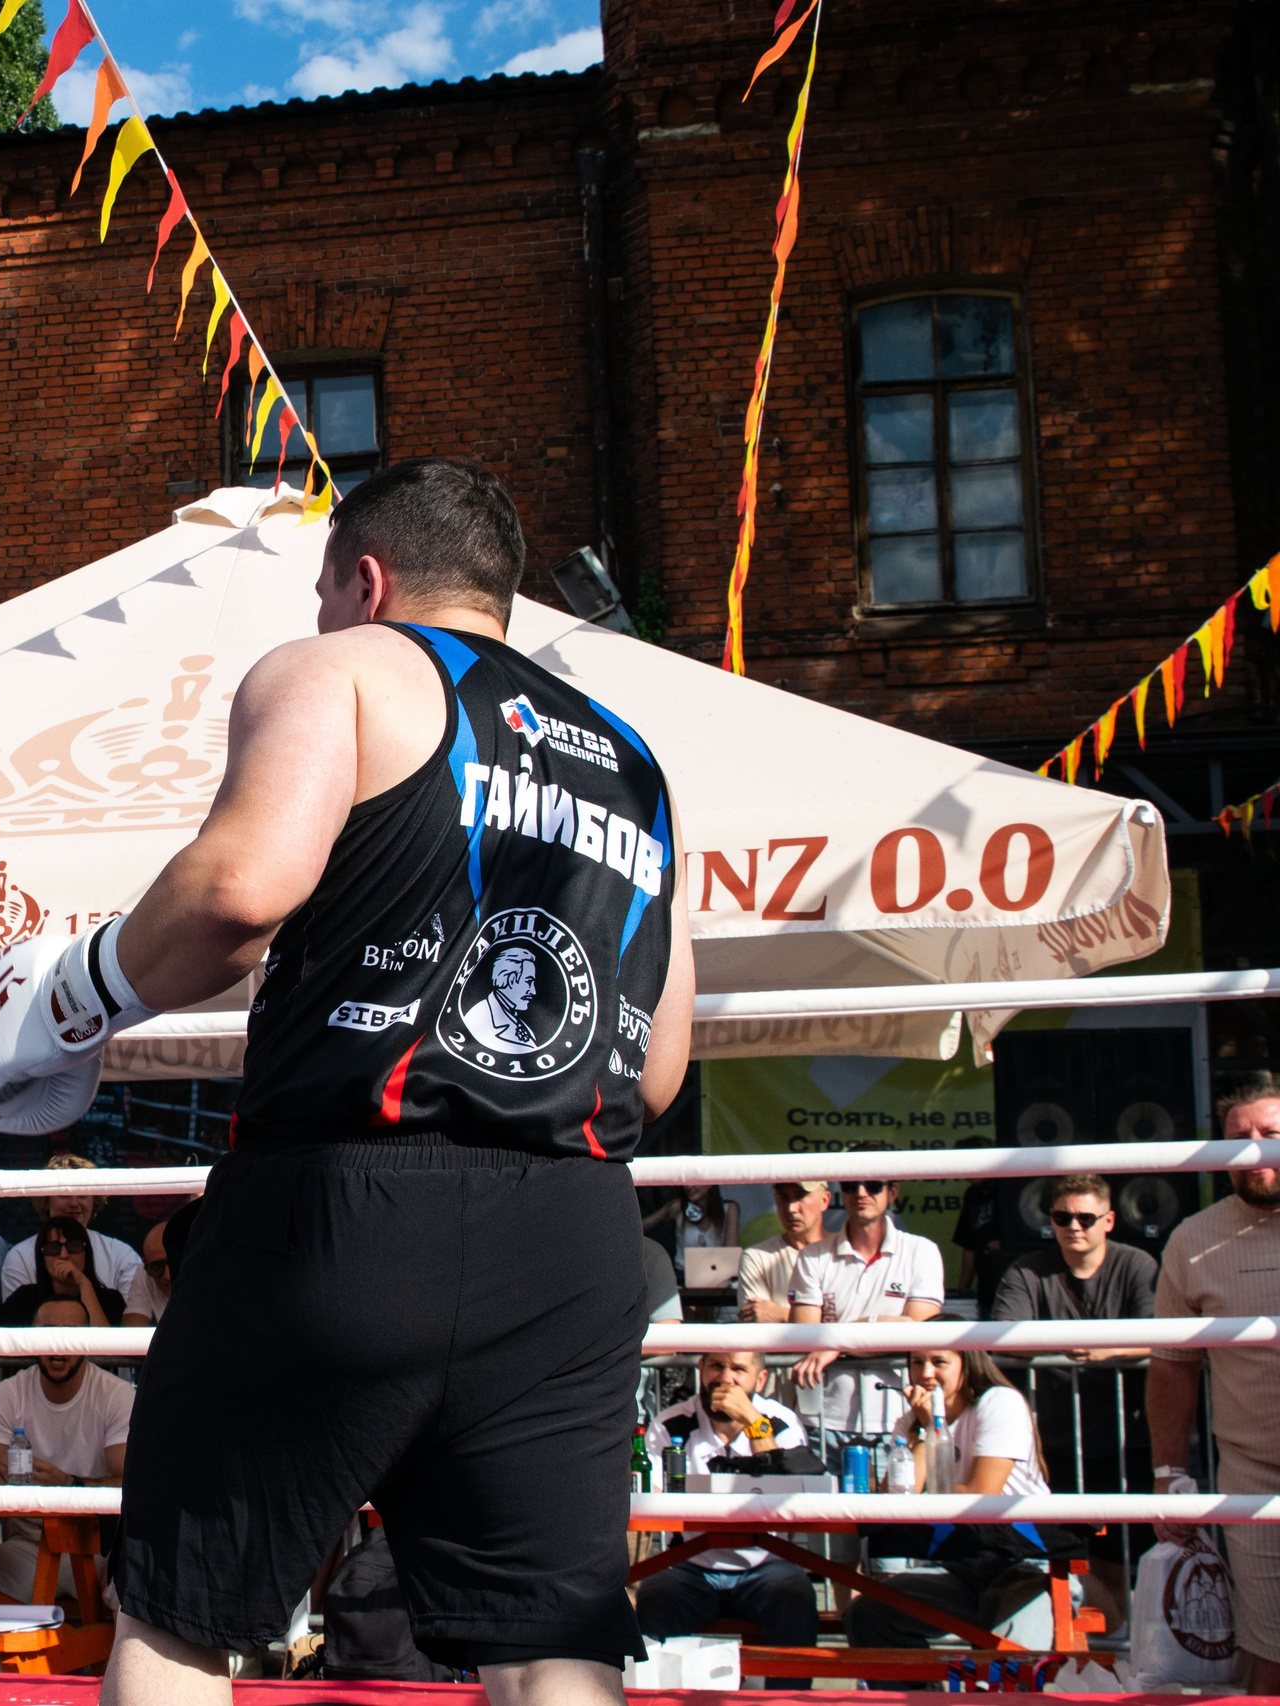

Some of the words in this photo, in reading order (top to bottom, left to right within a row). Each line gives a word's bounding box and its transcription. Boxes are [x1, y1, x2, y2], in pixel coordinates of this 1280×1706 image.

[536, 713, 617, 759] БИТВА
[547, 737, 619, 773] БЩЕПИТОВ
[460, 753, 663, 896] ГАЙИБОВ
[685, 836, 828, 921] NZ
[870, 823, 1055, 914] 0.0
[456, 914, 591, 1025] КАНЦЛЕРЪ
[448, 1031, 555, 1073] 2010
[786, 1107, 903, 1129] Стоять,
[909, 1111, 946, 1126] не
[952, 1111, 993, 1129] дв
